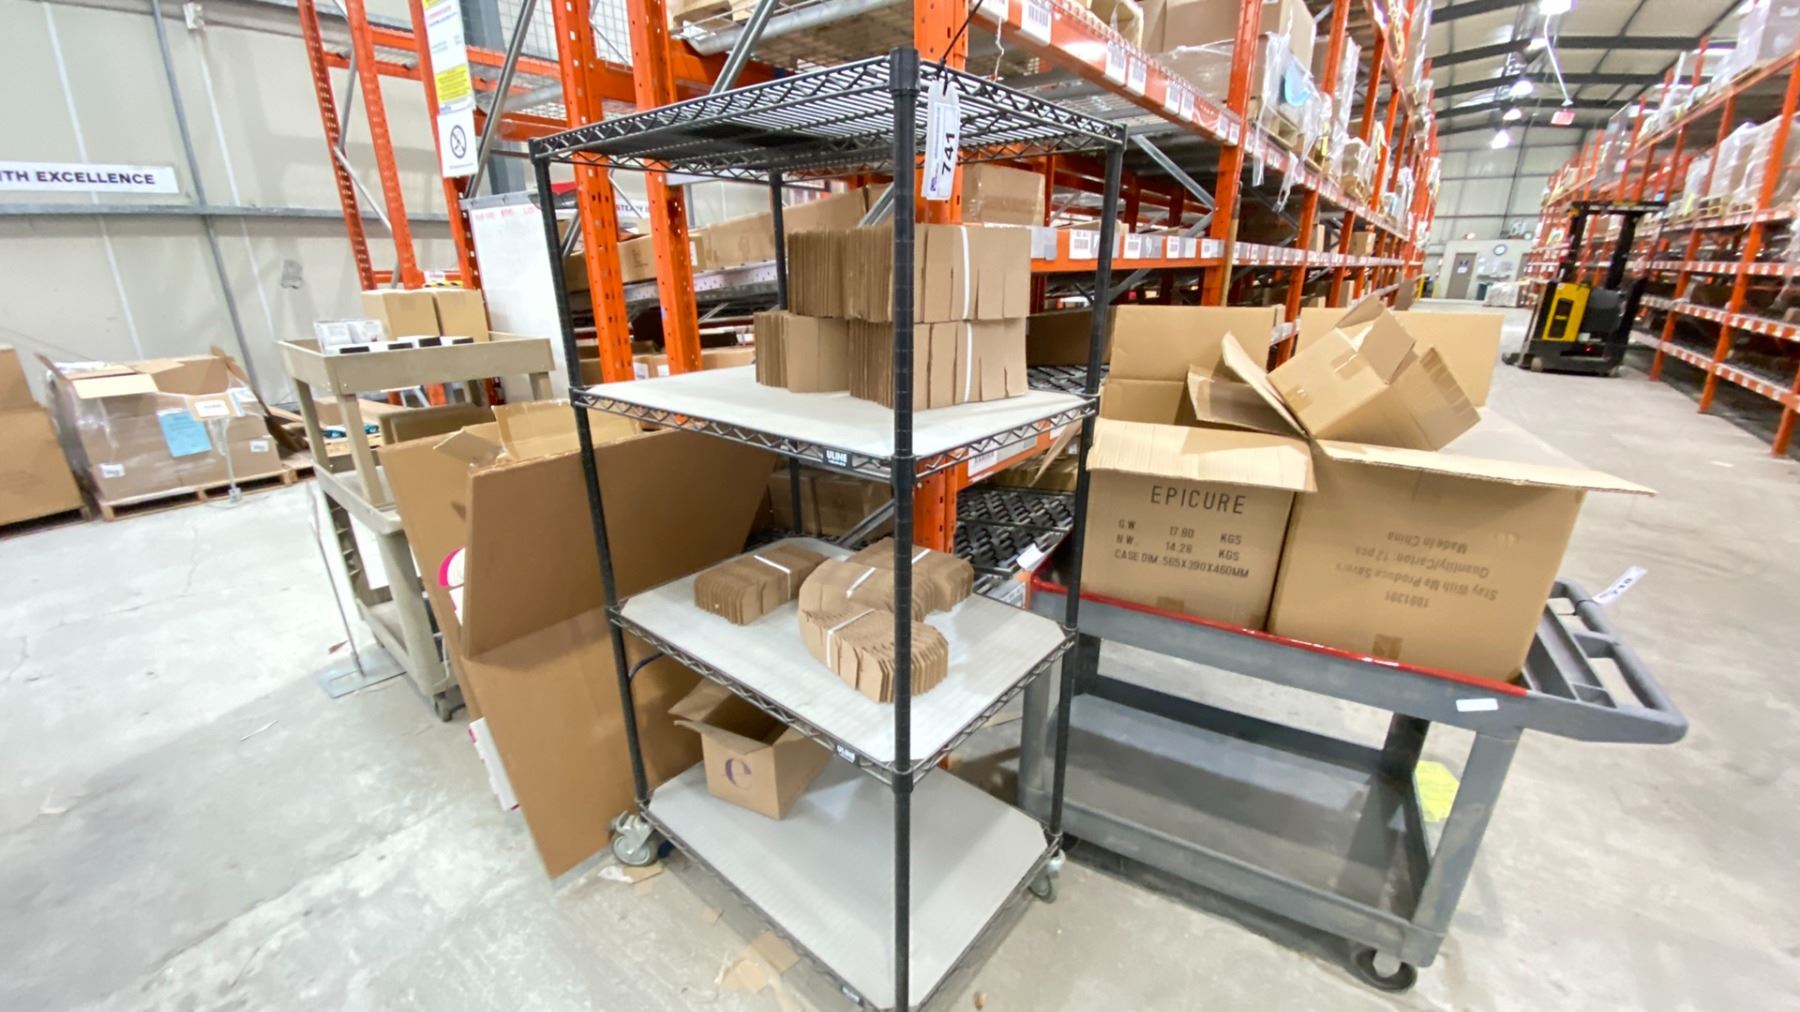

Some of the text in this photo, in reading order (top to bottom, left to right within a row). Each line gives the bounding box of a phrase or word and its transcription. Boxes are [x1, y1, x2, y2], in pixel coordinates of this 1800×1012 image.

[941, 132, 956, 176] 741
[36, 170, 156, 185] EXCELLENCE
[1150, 485, 1247, 515] EPICURE
[1220, 533, 1242, 546] KGS
[1387, 531, 1421, 547] China
[1434, 540, 1468, 555] Made
[1115, 549, 1138, 562] CASE
[1218, 549, 1240, 562] KGS
[1374, 568, 1422, 588] Produce
[1424, 578, 1440, 591] Me
[1442, 581, 1469, 595] With
[1472, 584, 1499, 601] Stay
